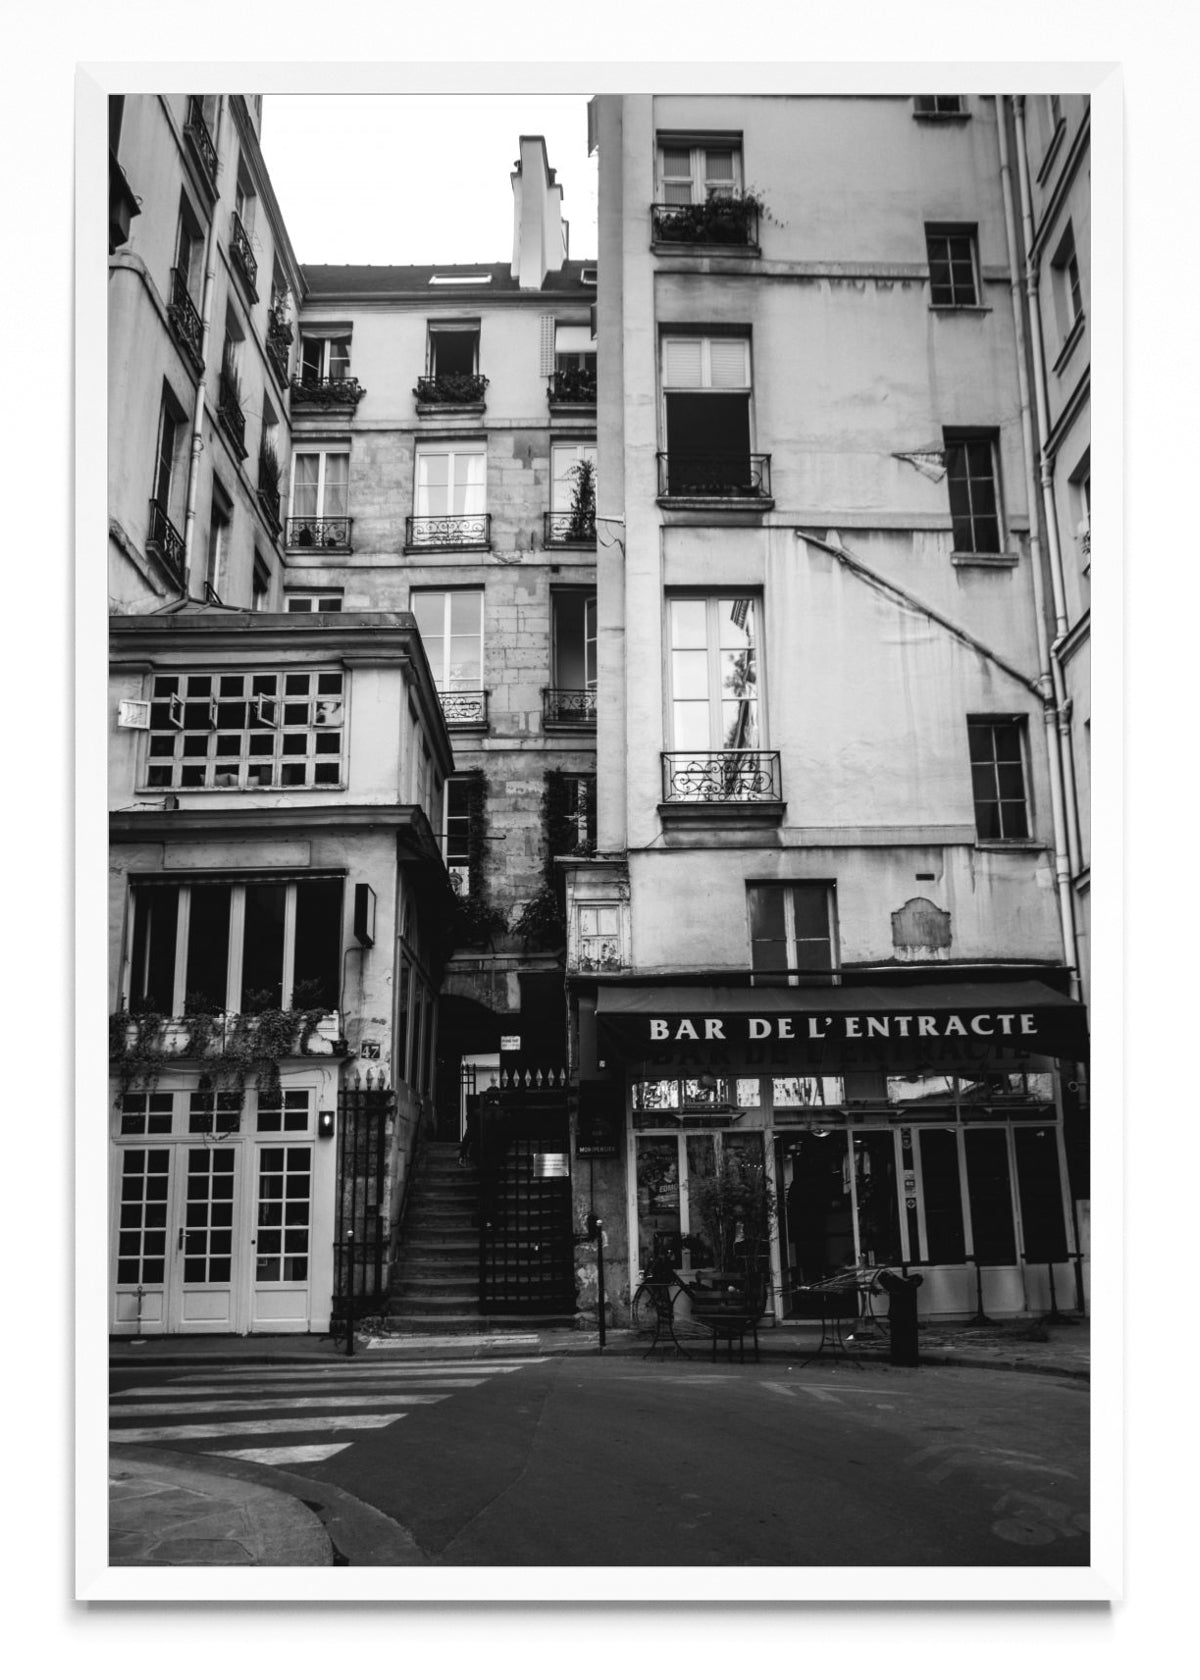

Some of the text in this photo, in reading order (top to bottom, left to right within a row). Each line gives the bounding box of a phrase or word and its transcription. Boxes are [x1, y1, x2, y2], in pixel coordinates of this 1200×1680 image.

[649, 1018, 725, 1040] BAR
[748, 1018, 794, 1039] DE
[362, 1045, 380, 1058] 47
